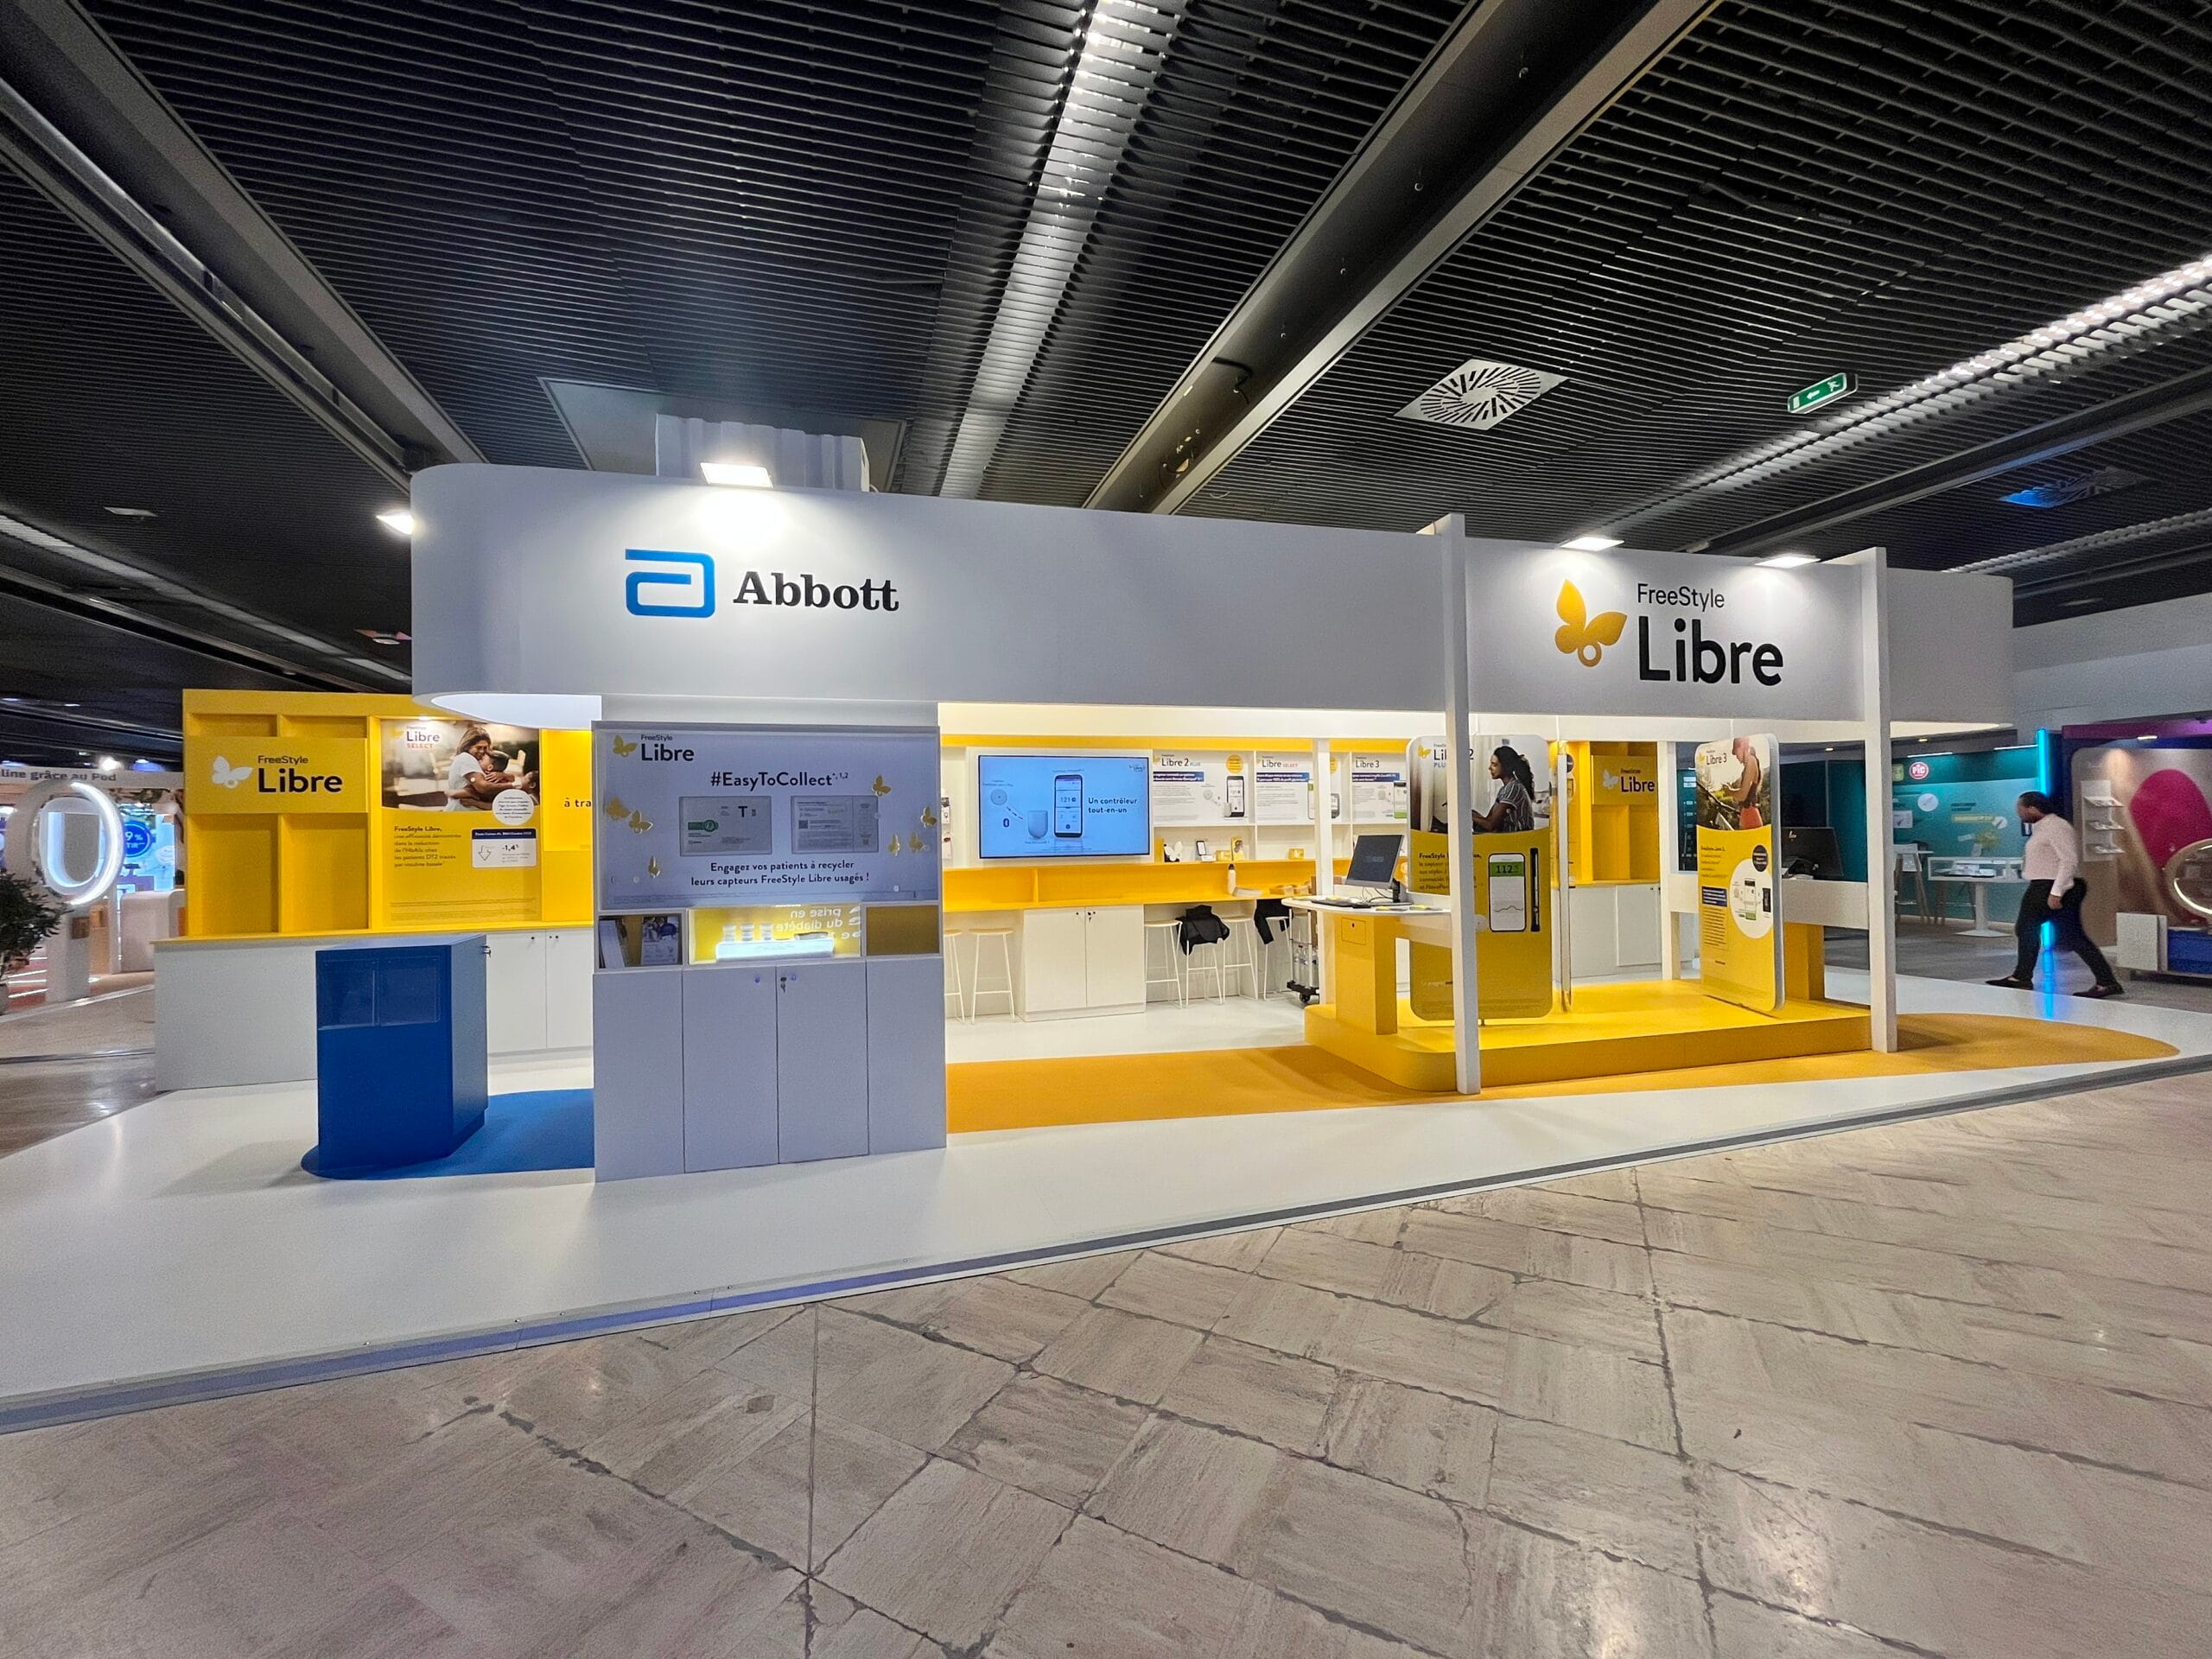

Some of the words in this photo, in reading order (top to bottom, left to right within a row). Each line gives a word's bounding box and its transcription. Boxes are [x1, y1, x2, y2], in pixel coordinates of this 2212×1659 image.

[733, 570, 899, 612] Abbott
[1637, 583, 1726, 613] FreeStyle
[1638, 615, 1784, 686] Libre
[406, 731, 440, 741] Libre
[641, 743, 695, 761] Libre
[257, 755, 308, 765] FreeStyle
[1161, 758, 1183, 766] Libre
[1184, 758, 1190, 766] 2
[1356, 760, 1374, 768] Libre
[92, 772, 117, 781] Pod
[258, 767, 343, 792] Libre
[1621, 776, 1655, 792] Libre
[564, 798, 570, 807] à
[710, 862, 749, 874] Engagez
[770, 861, 808, 873] patients
[818, 860, 855, 872] recycler
[1496, 865, 1513, 874] 112
[691, 876, 715, 886] leurs
[717, 876, 759, 887] capteurs
[761, 875, 805, 887] FreeStyle
[808, 874, 831, 883] Libre
[834, 874, 864, 885] usagés
